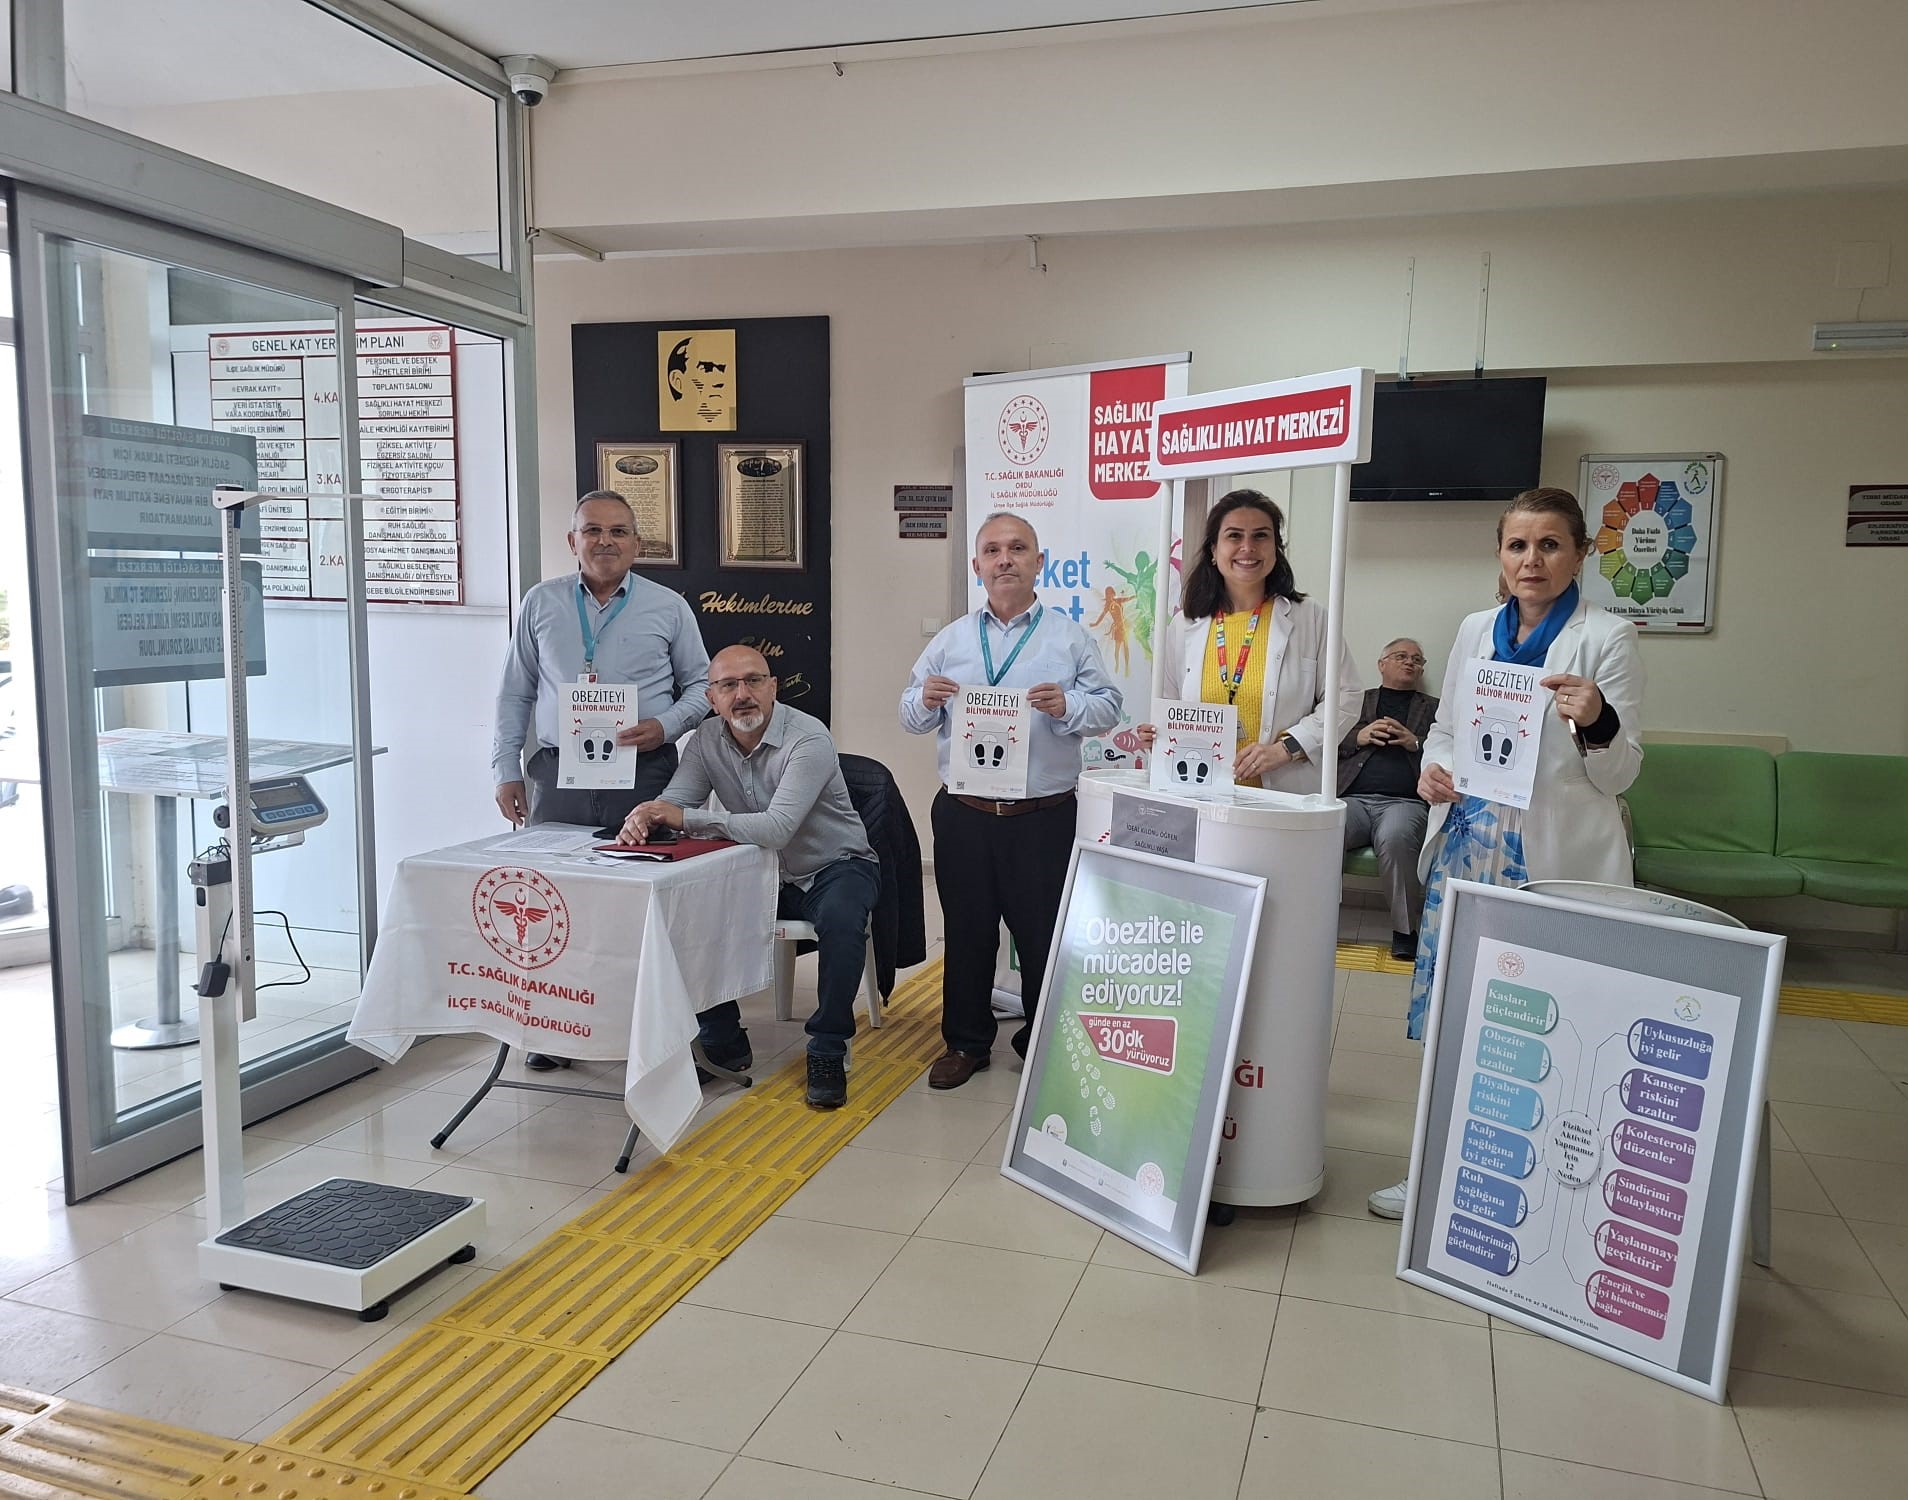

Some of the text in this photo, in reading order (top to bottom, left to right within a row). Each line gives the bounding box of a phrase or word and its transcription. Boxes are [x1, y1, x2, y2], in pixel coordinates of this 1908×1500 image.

[252, 336, 404, 352] GENEL KAT YERİM PLANI
[366, 357, 400, 365] PERSONEL
[412, 356, 438, 364] DESTEK
[372, 366, 432, 375] HİZMETLERİ BİRİMİ
[314, 391, 338, 404] 4.KA
[365, 399, 392, 407] SAĞLIKLI
[416, 398, 442, 406] MERKEZİ
[1094, 400, 1152, 426] SAĞLIKL
[1162, 399, 1344, 455] SAĞLIKLI HAYAT MERKEZİ
[376, 440, 432, 449] FİZİKSEL AKTİVİTE
[316, 472, 341, 485] 3.KA
[985, 468, 1064, 481] T.C. SAĞLIK BAKANLIĞI
[1094, 461, 1150, 483] MERKEZ
[382, 485, 430, 494] ERGOTERAPİST
[990, 489, 1058, 499] İL SAĞLIK MÜDÜRLÜĞÜ
[386, 506, 428, 514] EĞİTİM BİRİMİ
[402, 521, 426, 529] SAĞLIĞI
[320, 555, 345, 566] 2.KA
[416, 572, 452, 580] DİYETİSYEN
[700, 590, 813, 616] Hekimlerine
[1478, 668, 1534, 692] OBEZİTEYİ
[572, 688, 625, 703] OBEZİTEYİ
[966, 692, 1019, 708] OBEZİTEYİ
[1476, 686, 1532, 704] BİLİYOR MUYUZ?
[572, 704, 598, 712] BİLİYOR
[966, 707, 1018, 717] BİLİYOR MUYUZ?
[1168, 707, 1224, 724] OBEZİTEYİ
[1168, 722, 1223, 733] BİLİYOR MUYUZ?
[1086, 915, 1204, 946] Obezite ile
[1083, 948, 1192, 975] mücadele
[448, 961, 595, 1007] T.C. SAĞLIK BAKANLIĞI
[507, 990, 531, 1012] ÜNYE
[1081, 979, 1183, 1011] ediyoruz!
[1488, 988, 1528, 1007] Kasları
[447, 995, 592, 1038] İLÇE SAĞLIK MÜDÜRLÜĞÜ
[1088, 1018, 1111, 1028] günde
[1486, 1004, 1546, 1027] güçlendirir
[1485, 1029, 1526, 1048] Obezite
[1643, 1025, 1713, 1053] Uykusuzluğa
[1126, 1048, 1170, 1067] yürüyoruz
[1482, 1043, 1517, 1060] riskini
[1640, 1041, 1682, 1062] iyi gelir
[1480, 1057, 1515, 1074] azaltır
[1479, 1075, 1520, 1096] Diyabet
[1623, 1082, 1630, 1092] 8
[1642, 1073, 1687, 1094] Kanser
[1476, 1090, 1511, 1108] riskini
[1640, 1089, 1680, 1108] riskini
[1474, 1104, 1509, 1121] azaltır
[1637, 1103, 1677, 1123] azaltır
[1470, 1122, 1496, 1138] Kalp
[1562, 1120, 1592, 1136] Fiziksel
[1616, 1132, 1622, 1142] 9
[1467, 1136, 1514, 1159] sağlığına
[1560, 1131, 1591, 1146] Aktivite
[1626, 1125, 1695, 1156] Kolesterolü
[1554, 1138, 1594, 1158] Yapmamız
[1563, 1151, 1579, 1163] İçin
[1623, 1141, 1676, 1166] düzenler
[1465, 1149, 1506, 1171] iyi gelir
[1565, 1162, 1574, 1171] 12
[1461, 1168, 1484, 1184] Ruh
[1557, 1170, 1582, 1184] Neden
[1458, 1184, 1505, 1208] sağlığına
[1618, 1176, 1671, 1203] Sindirimi
[1456, 1196, 1497, 1218] iyi gelir
[1518, 1205, 1525, 1214] 5
[1616, 1190, 1683, 1222] kolaylaştırır
[1450, 1219, 1512, 1252] Kemiklerimizi
[1448, 1235, 1496, 1261] güçlendirir
[1609, 1228, 1678, 1263] Yaşlanmayı
[1510, 1252, 1516, 1262] 6
[1606, 1245, 1663, 1273] geçiktirir
[1600, 1274, 1634, 1295] Enerjik
[1596, 1300, 1624, 1318] sağlar
[1598, 1288, 1668, 1321] iyi hissetmemizi
